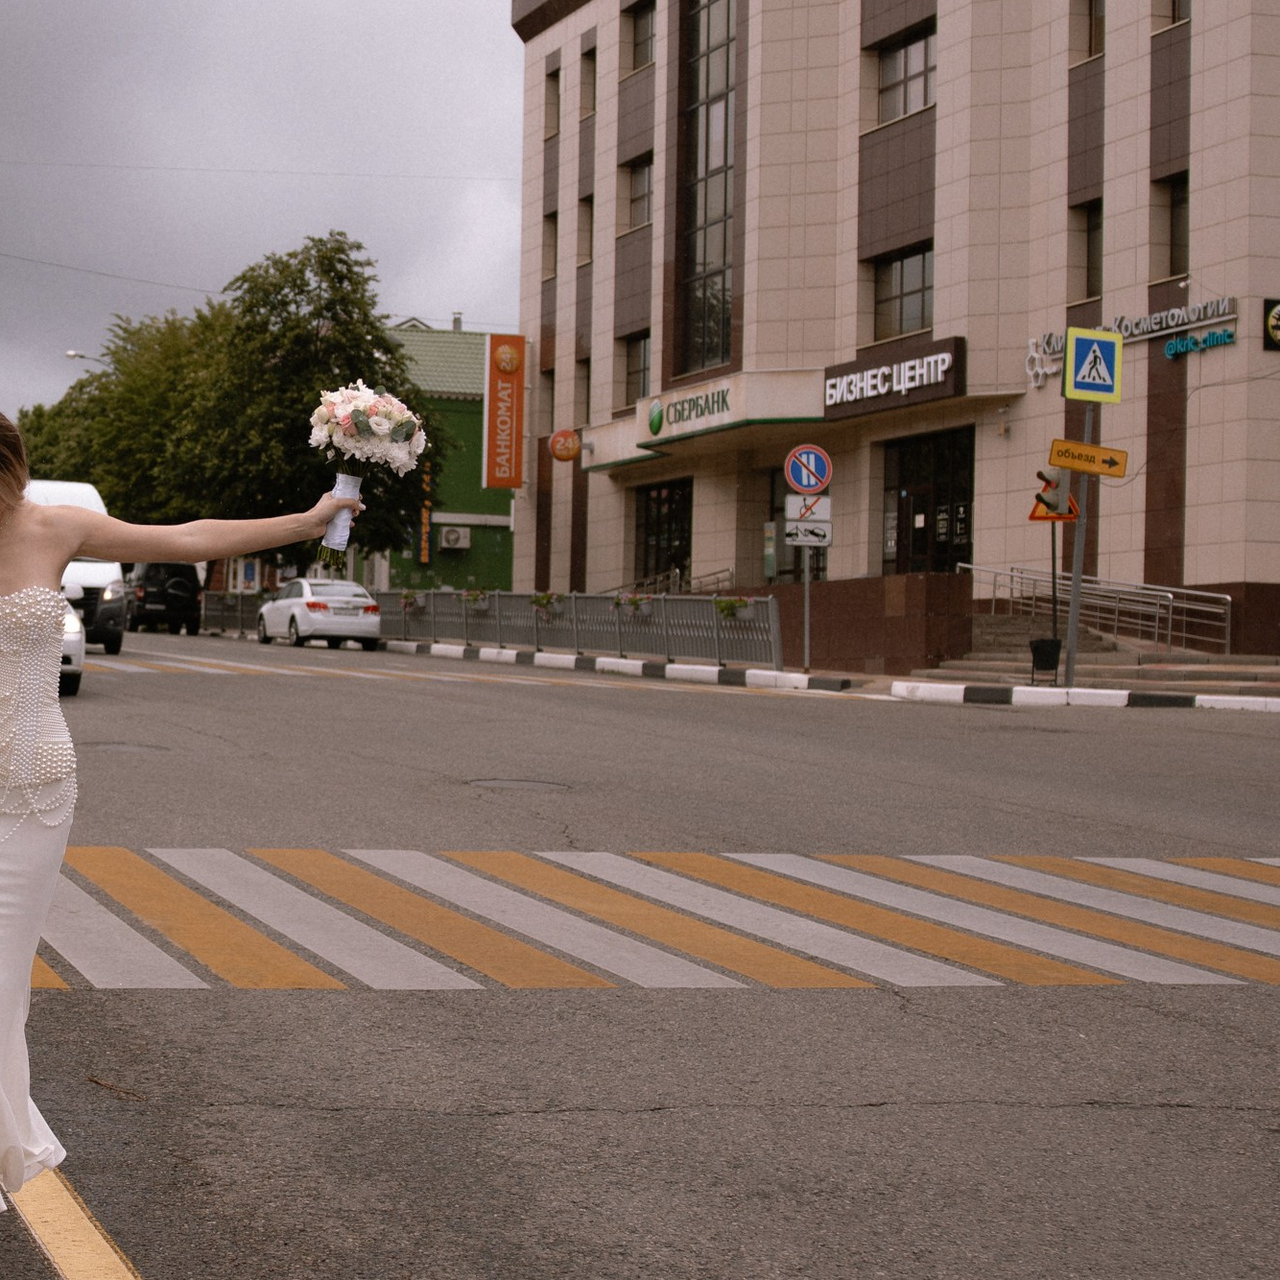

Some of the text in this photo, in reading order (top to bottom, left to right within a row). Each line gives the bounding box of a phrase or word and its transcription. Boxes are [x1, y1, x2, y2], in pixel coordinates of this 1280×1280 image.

[825, 352, 952, 406] БИЗНЕС ЦЕНТР
[495, 379, 513, 478] БАНКОМАТ
[666, 388, 730, 425] СБЕРБАНК
[1057, 448, 1096, 464] объезд
